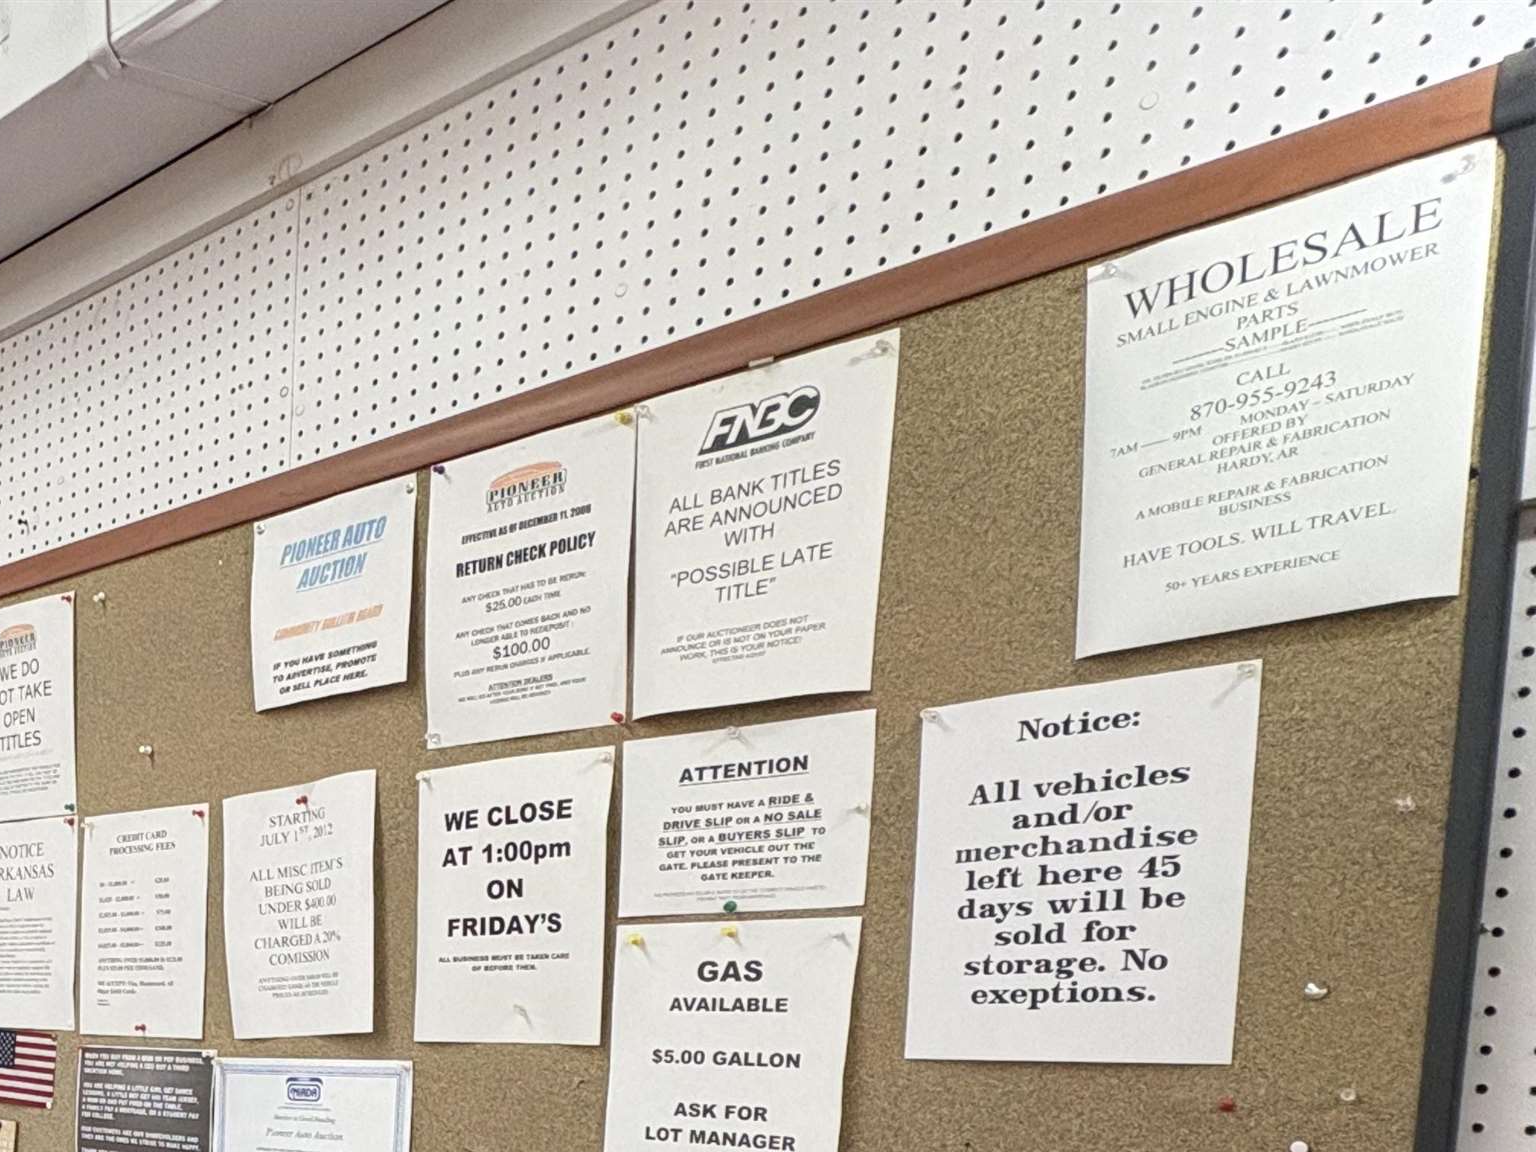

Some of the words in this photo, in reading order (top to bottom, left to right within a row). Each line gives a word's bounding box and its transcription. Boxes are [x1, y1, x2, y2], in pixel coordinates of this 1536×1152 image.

[1124, 198, 1443, 320] WHOLESALE
[1117, 319, 1179, 348] SMALL
[1184, 294, 1258, 327] ENGINE
[1264, 287, 1279, 302] &
[1286, 242, 1440, 297] LAWNMOWER
[1236, 302, 1299, 330] PARTS
[1236, 363, 1291, 387] CALL
[1191, 371, 1337, 420] 870-955-9243
[698, 385, 821, 455] FNBC
[669, 493, 703, 514] ALL
[711, 478, 764, 503] BANK
[770, 460, 841, 491] TITLES
[665, 516, 704, 537] ARE
[710, 484, 843, 527] ANNOUNCED
[281, 531, 339, 565] PIONEER
[342, 516, 387, 547] AUTO
[725, 524, 775, 546] WITH
[1122, 546, 1173, 569] HAVE
[1252, 519, 1303, 541] WILL
[456, 555, 503, 578] RETURN
[506, 541, 548, 567] CHECK
[550, 531, 596, 556] POLICY
[781, 542, 833, 567] LATE
[297, 553, 368, 589] AUCTION
[1165, 579, 1188, 593] 50+
[1192, 569, 1239, 588] YEARS
[1244, 550, 1340, 578] EXPERIENCE
[493, 637, 550, 659] $100.00
[0, 665, 18, 682] WE
[22, 659, 40, 677] DO
[336, 654, 376, 670] PROMOTE
[18, 680, 52, 701] TAKE
[4, 708, 35, 728] OPEN
[1017, 709, 1141, 743] Notice:
[0, 730, 41, 752] TITLES
[679, 755, 809, 783] ATTENTION
[969, 779, 1020, 806] All
[1034, 764, 1191, 798] vehicles
[444, 810, 479, 832] WE
[487, 798, 573, 827] CLOSE
[672, 806, 692, 814] YOU
[695, 803, 723, 812] MUST
[727, 800, 756, 809] HAVE
[758, 799, 764, 807] A
[768, 794, 799, 805] RIDE
[805, 793, 813, 802] &
[1011, 800, 1133, 830] and/or
[269, 807, 325, 828] STARTING
[0, 843, 45, 860] NOTICE
[442, 847, 472, 867] AT
[482, 840, 571, 865] 1:00pm
[955, 826, 1198, 864] merchandise
[965, 867, 1023, 891] left
[1037, 865, 1123, 887] here
[1137, 854, 1181, 879] 45
[7, 888, 35, 902] LAW
[487, 879, 523, 899] ON
[957, 898, 1032, 923] days
[1048, 889, 1125, 914] will
[1142, 887, 1185, 909] be
[447, 913, 562, 937] FRIDAY'S
[995, 923, 1065, 946] sold
[1082, 921, 1136, 943] for
[269, 949, 330, 967] COMISSION
[697, 961, 763, 982] GAS
[964, 953, 1105, 980] storage.
[1120, 948, 1168, 972] No
[669, 998, 788, 1013] AVAILABLE
[970, 980, 1156, 1009] exeptions.
[652, 1049, 705, 1065] $5.00
[713, 1051, 801, 1068] GALLON
[674, 1103, 717, 1118] ASK
[725, 1106, 767, 1121] FOR
[645, 1127, 682, 1142] LOT
[690, 1130, 795, 1151] MANAGER
